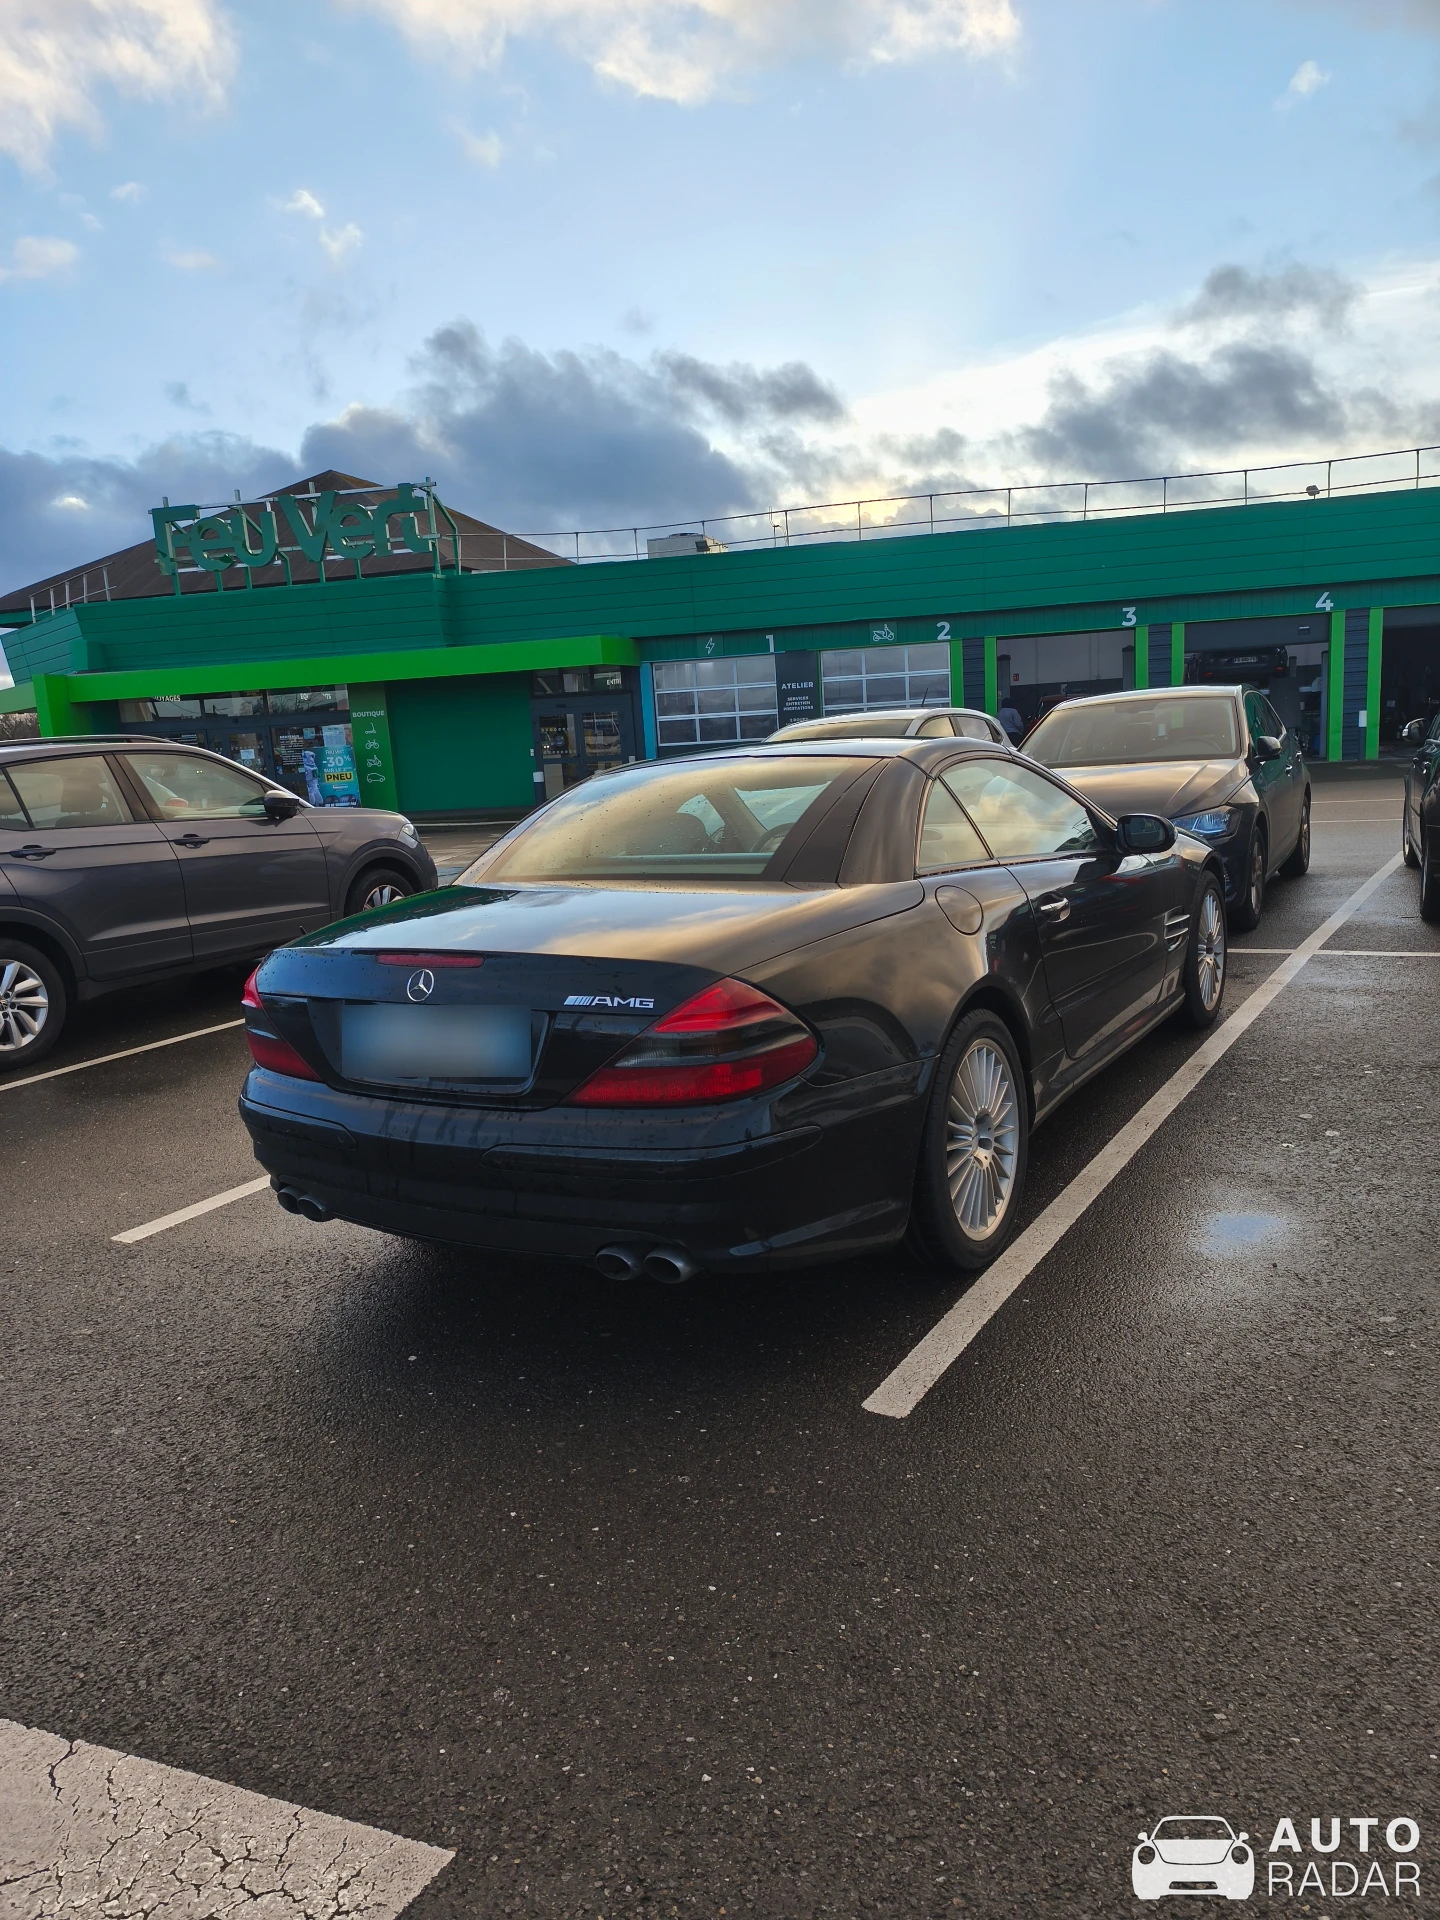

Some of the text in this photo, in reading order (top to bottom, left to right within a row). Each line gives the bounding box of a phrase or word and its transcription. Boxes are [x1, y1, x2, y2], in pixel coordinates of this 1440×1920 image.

[1315, 591, 1334, 611] 4
[1121, 606, 1137, 627] 3
[936, 621, 951, 640] 2
[765, 634, 775, 653] 1
[781, 681, 814, 690] ATELIER
[352, 710, 385, 718] BOUTIQUE
[326, 772, 352, 781] PNEU
[591, 996, 655, 1009] AMG
